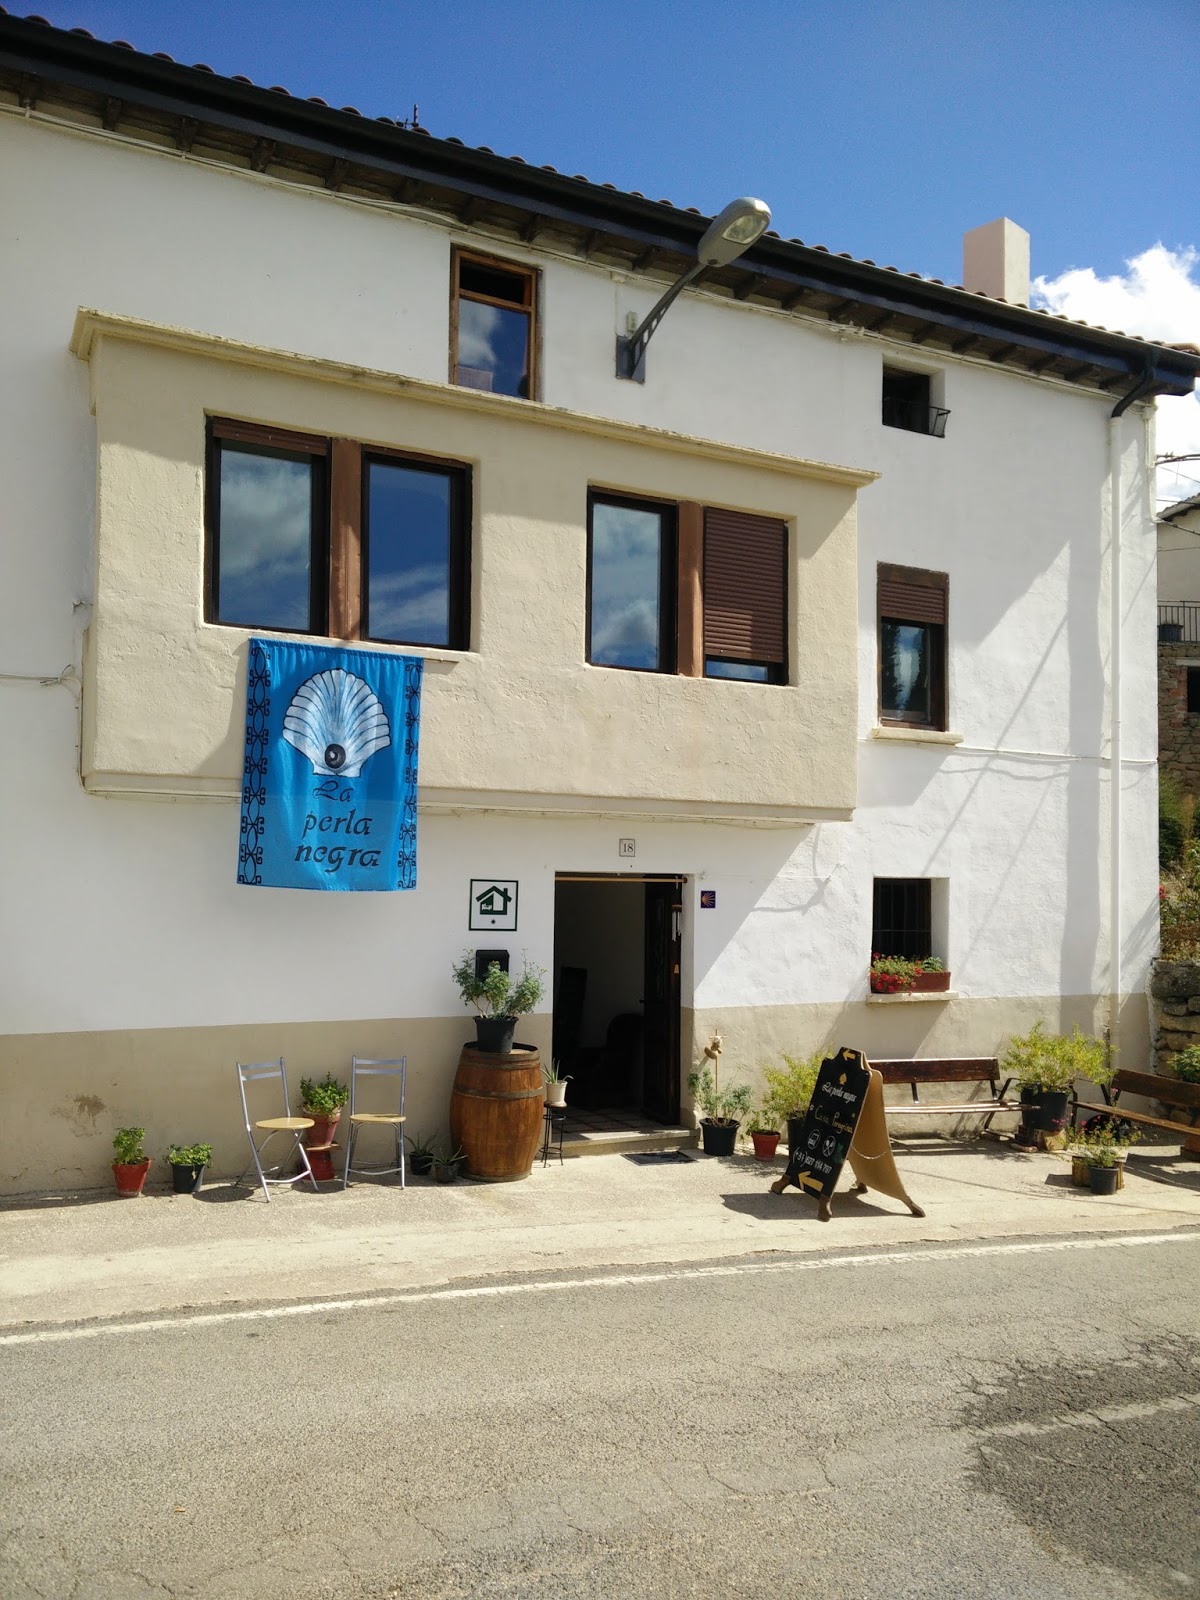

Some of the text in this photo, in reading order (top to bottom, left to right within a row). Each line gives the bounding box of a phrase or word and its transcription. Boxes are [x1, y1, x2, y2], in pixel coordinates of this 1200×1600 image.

[313, 780, 354, 802] La
[302, 808, 373, 839] perla
[294, 844, 381, 873] negra
[623, 842, 634, 853] 18
